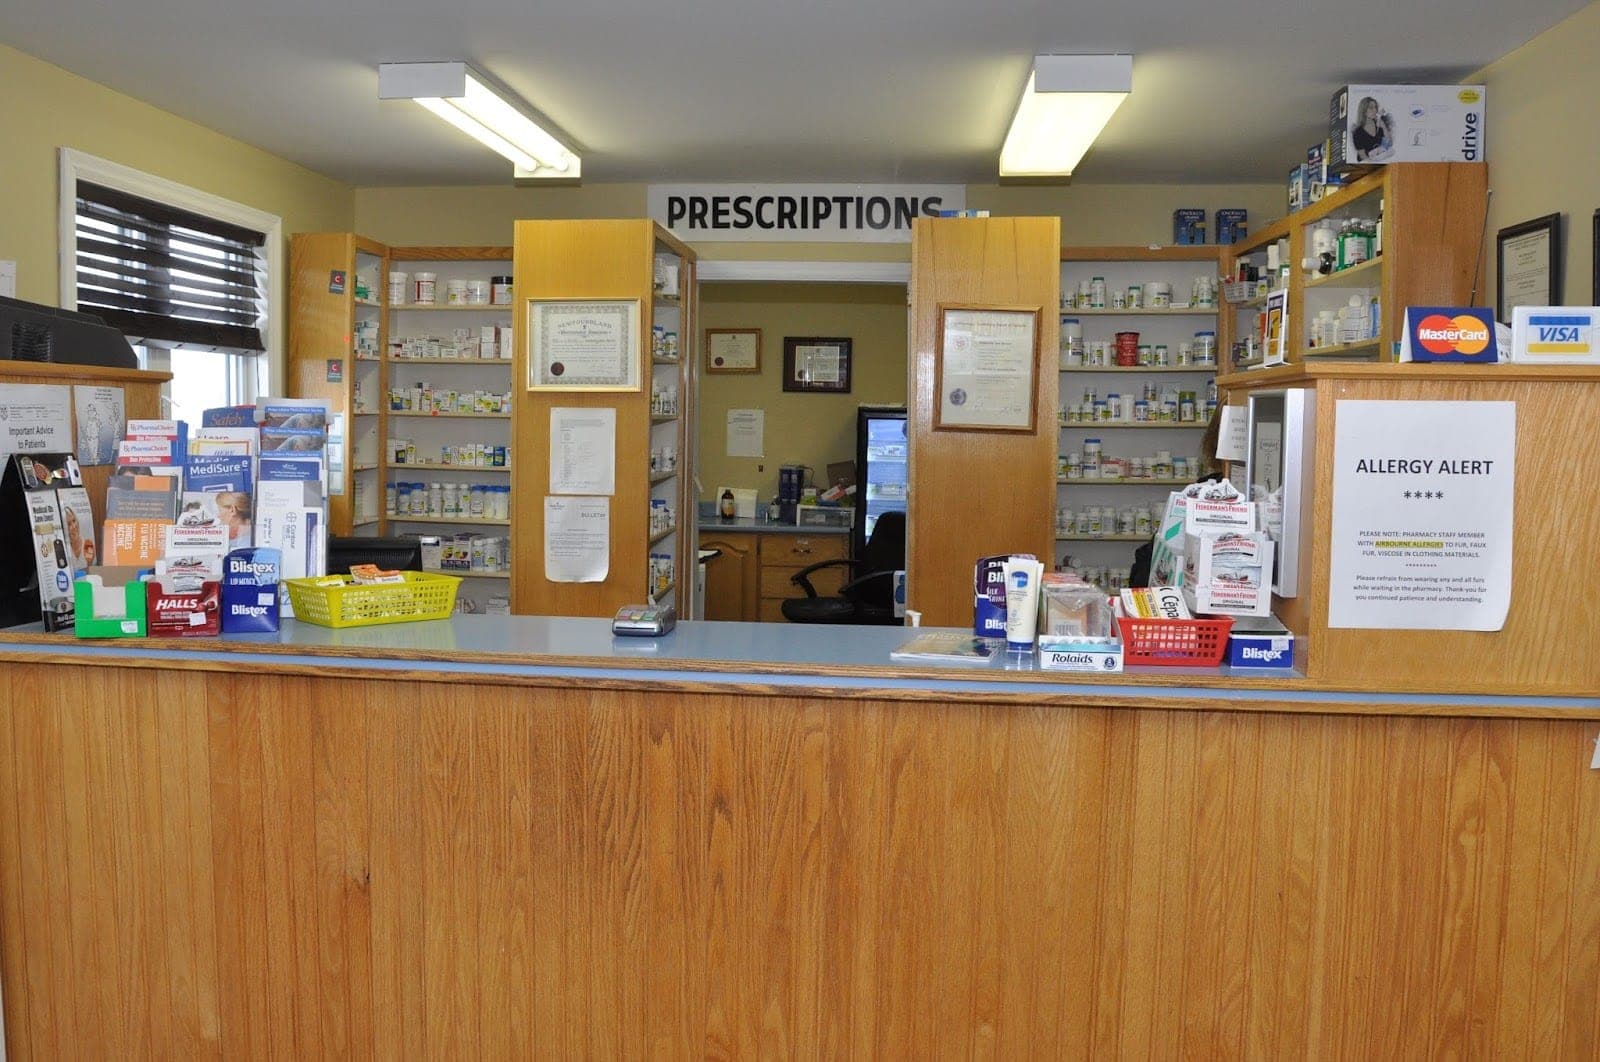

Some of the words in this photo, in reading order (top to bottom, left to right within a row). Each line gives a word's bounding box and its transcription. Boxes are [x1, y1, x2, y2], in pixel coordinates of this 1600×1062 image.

[1462, 112, 1476, 160] drive
[668, 196, 943, 230] PRESCRIPTIONS
[1419, 328, 1488, 340] MasterCard
[1538, 328, 1579, 342] VISA
[8, 426, 34, 438] Important
[36, 426, 54, 434] Advice
[24, 440, 46, 448] Patients
[190, 463, 240, 474] MediSure
[1356, 459, 1434, 474] ALLERGY
[1438, 460, 1494, 474] ALERT
[230, 560, 274, 576] Blistex
[156, 599, 198, 611] HALLS
[232, 604, 268, 616] Blistex
[1052, 653, 1094, 664] Rolaids
[1242, 647, 1282, 662] Blistex
